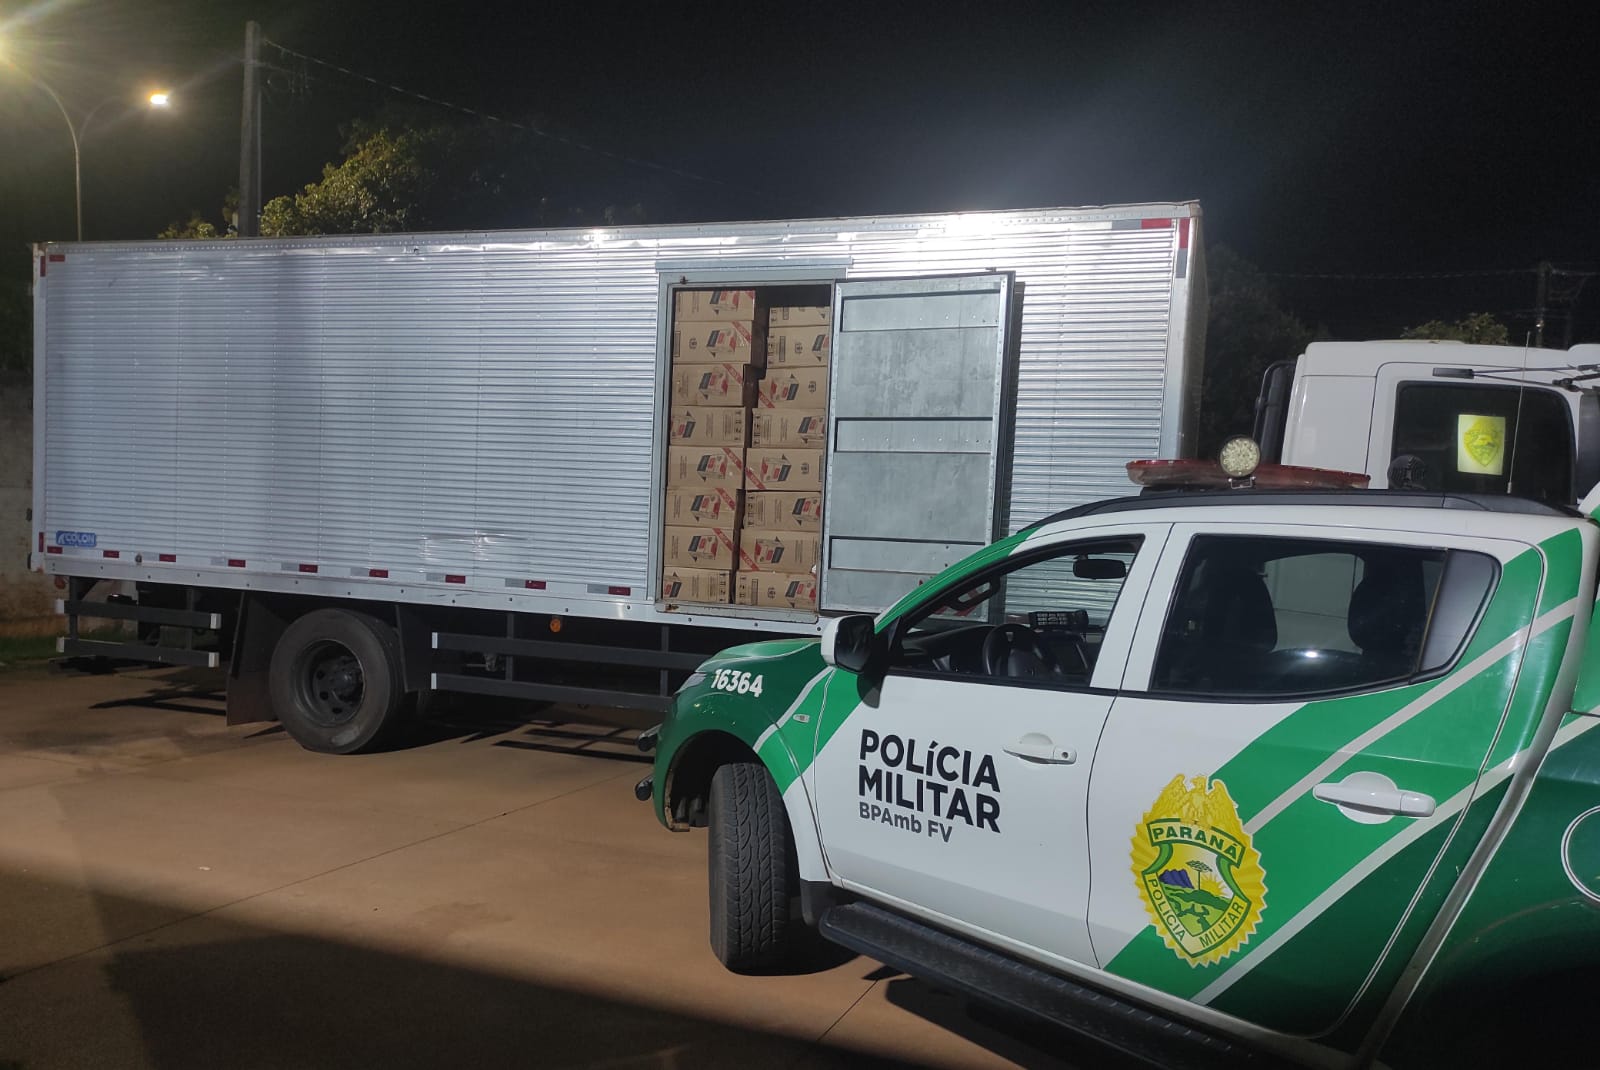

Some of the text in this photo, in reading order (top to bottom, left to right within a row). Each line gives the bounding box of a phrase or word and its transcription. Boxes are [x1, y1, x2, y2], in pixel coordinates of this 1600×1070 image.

[711, 669, 763, 697] 16364
[859, 765, 1000, 833] MILITAR
[859, 802, 952, 842] BPAmb FV
[1152, 826, 1240, 860] PARANÁ
[1148, 879, 1244, 948] POLICIA MILITAR
